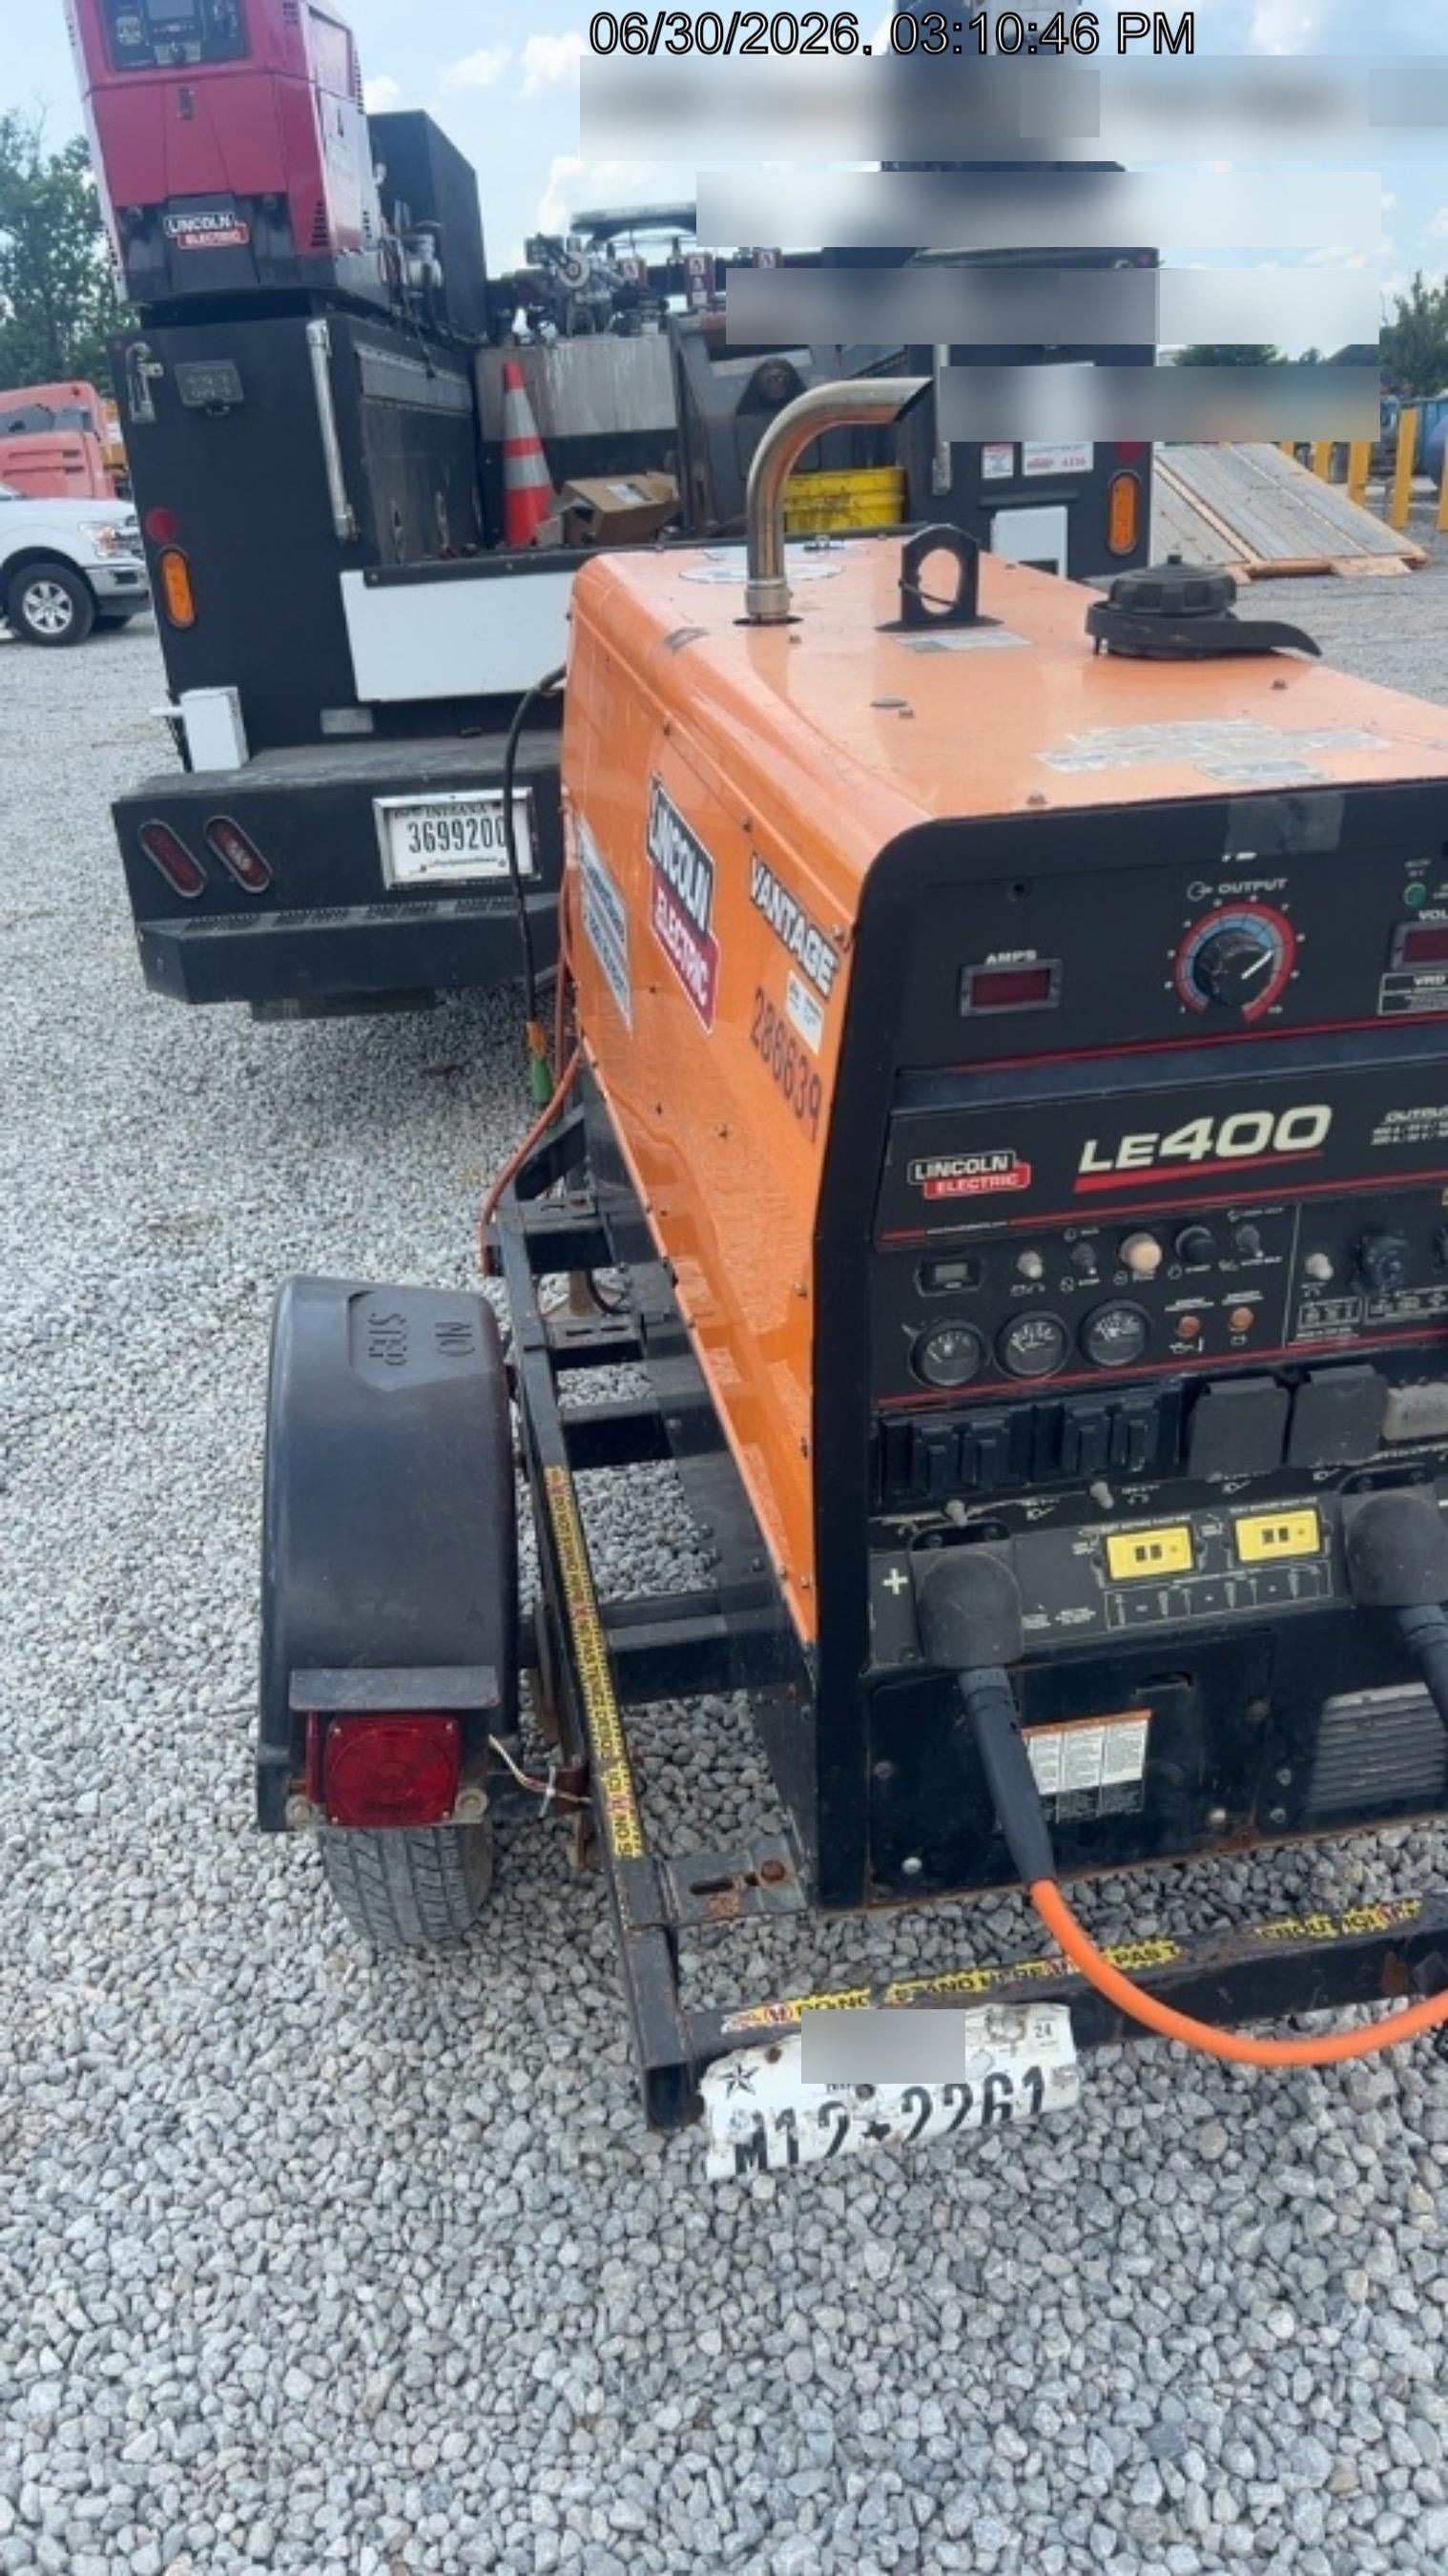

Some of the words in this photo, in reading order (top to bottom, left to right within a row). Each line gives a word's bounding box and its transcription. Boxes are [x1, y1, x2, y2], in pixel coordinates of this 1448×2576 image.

[165, 214, 232, 233] LINCOLN
[652, 802, 712, 932] LINCOLN
[1218, 878, 1288, 895] OUTPUT
[752, 857, 836, 997] VANTAGE
[656, 887, 709, 1007] ELECTRIC
[984, 950, 1037, 966] AMPS
[1079, 1105, 1333, 1174] LE400
[914, 1153, 1008, 1181] LINCOLN
[934, 1171, 1019, 1192] ELECTRIC
[367, 1313, 408, 1365] STEP
[434, 1321, 475, 1357] NO
